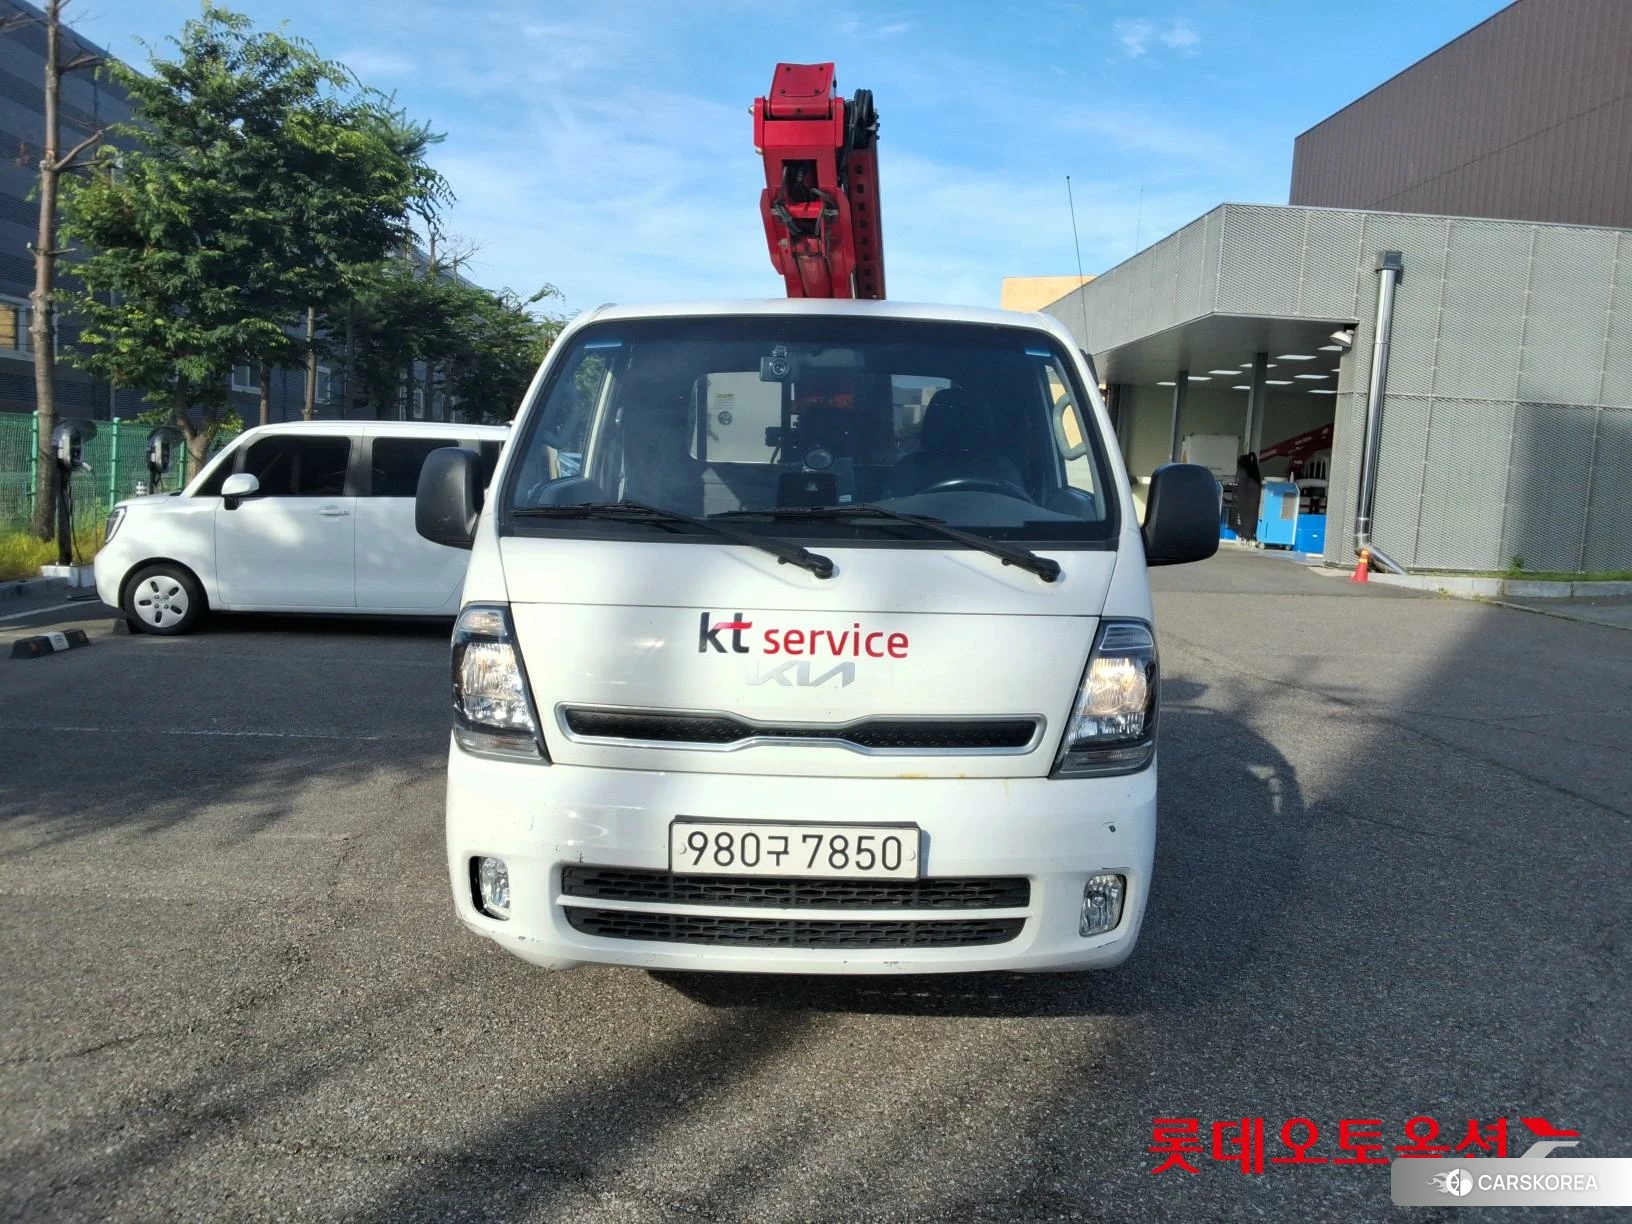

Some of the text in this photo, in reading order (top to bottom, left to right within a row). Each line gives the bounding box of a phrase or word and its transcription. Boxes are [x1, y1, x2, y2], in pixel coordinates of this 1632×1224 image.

[698, 611, 909, 659] kt service
[801, 833, 902, 871] 7850
